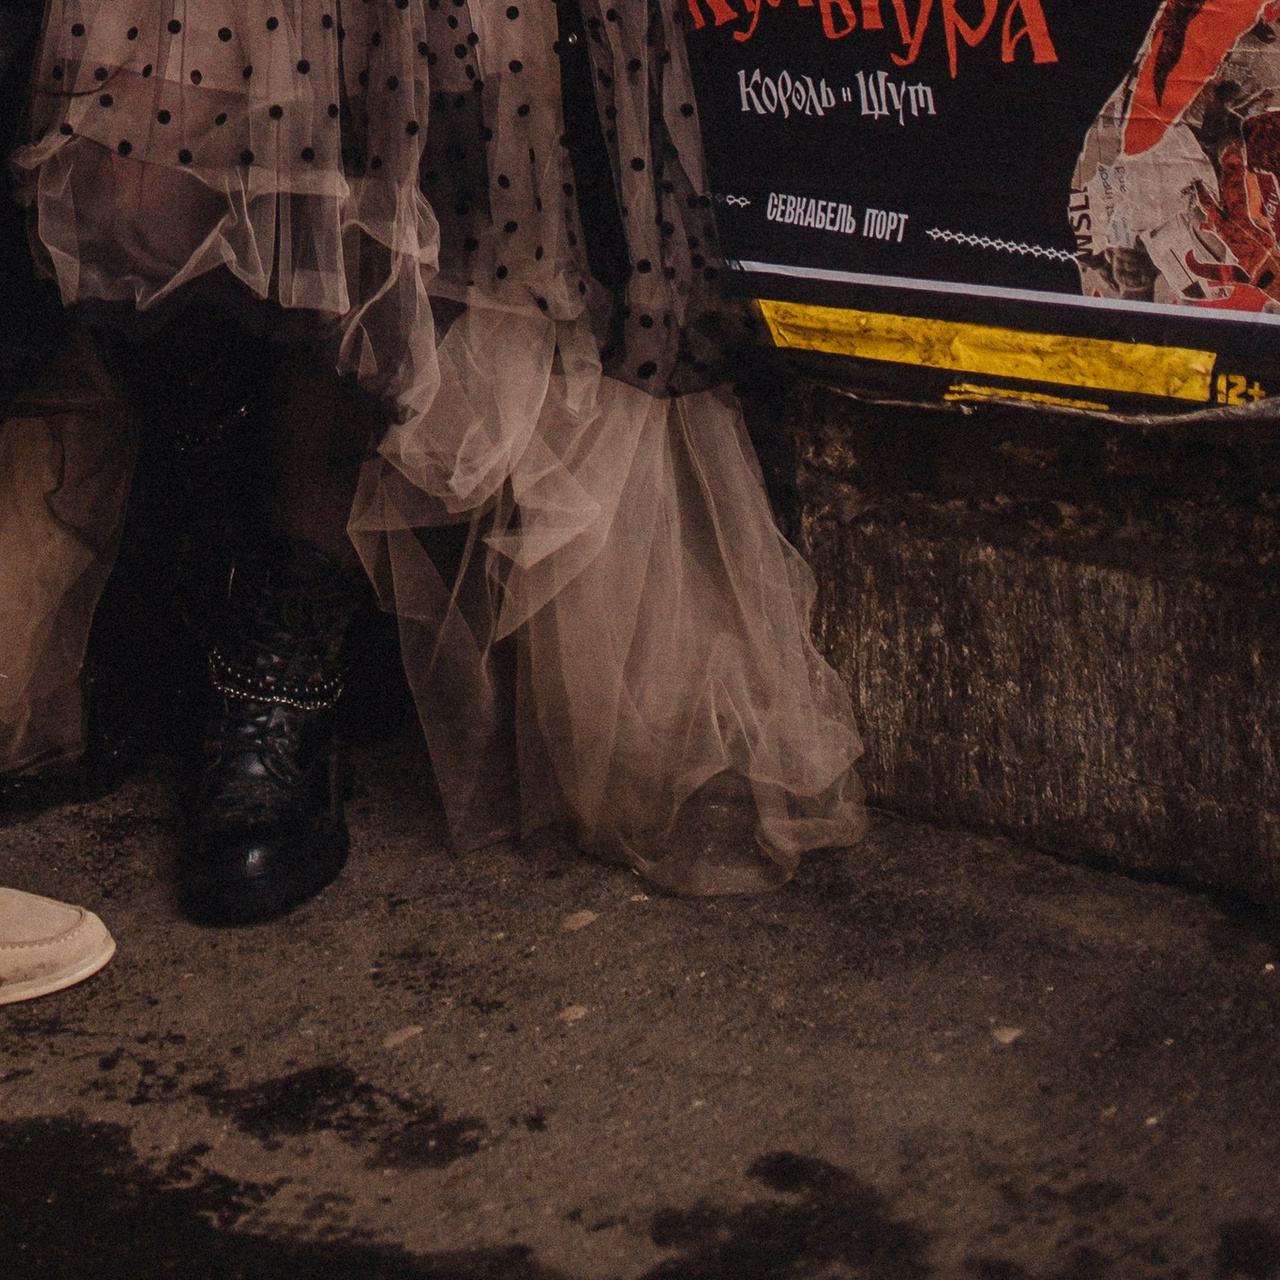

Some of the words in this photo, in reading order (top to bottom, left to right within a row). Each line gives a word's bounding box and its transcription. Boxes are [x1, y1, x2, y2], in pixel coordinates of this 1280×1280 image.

[766, 192, 856, 236] СЕВКАБЕЛЬ
[862, 206, 909, 243] ПОРТ
[1217, 372, 1267, 407] 12+
